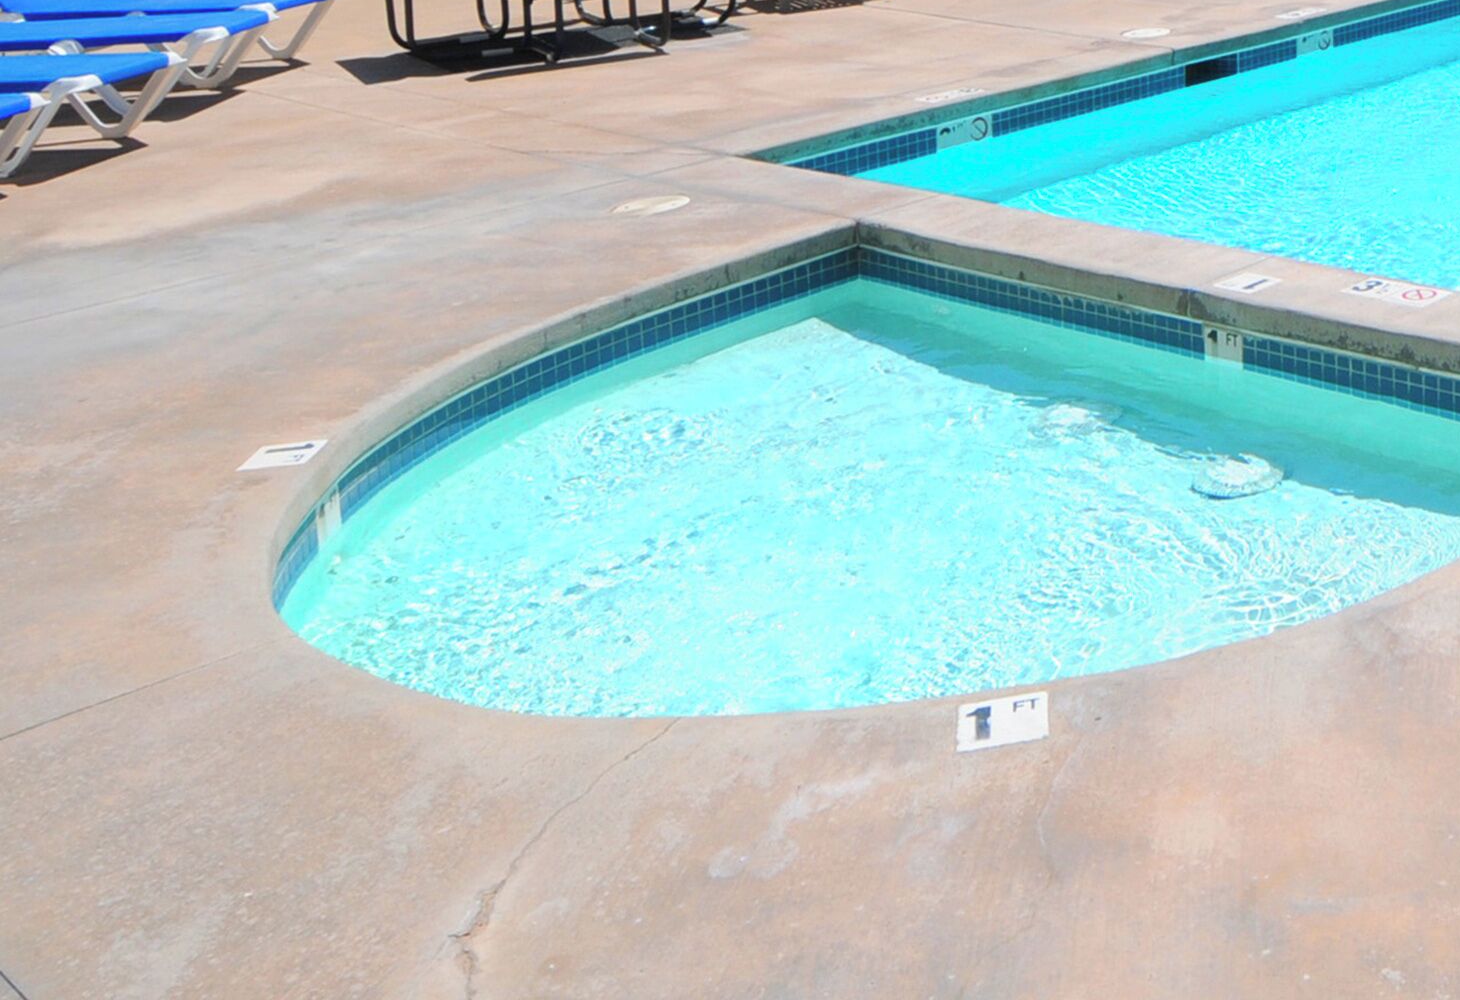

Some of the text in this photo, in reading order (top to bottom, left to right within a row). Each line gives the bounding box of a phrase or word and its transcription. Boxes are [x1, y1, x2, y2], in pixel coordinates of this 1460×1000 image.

[1226, 333, 1238, 347] FT
[265, 443, 315, 454] 1
[966, 697, 1040, 740] 1 FT
